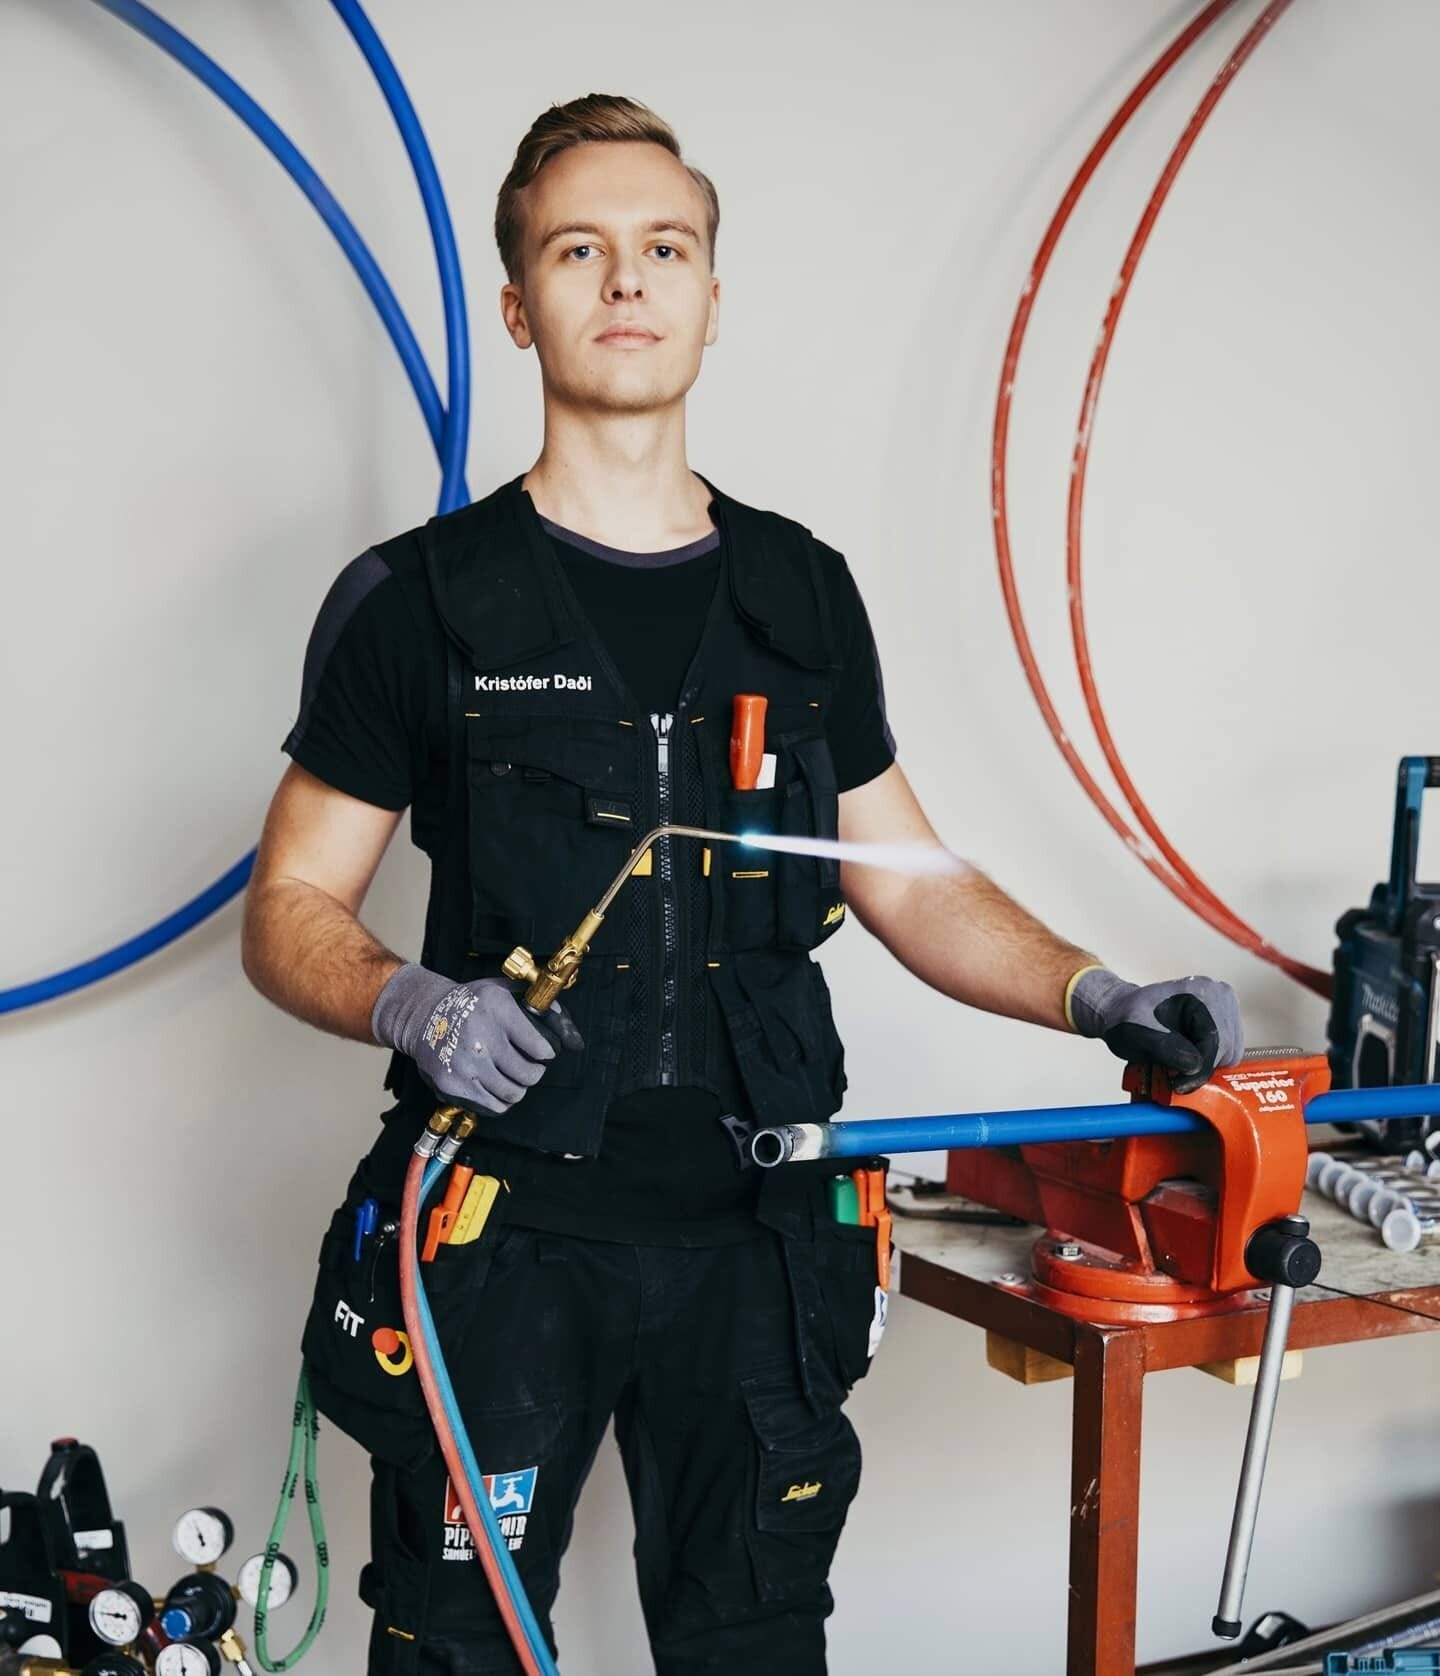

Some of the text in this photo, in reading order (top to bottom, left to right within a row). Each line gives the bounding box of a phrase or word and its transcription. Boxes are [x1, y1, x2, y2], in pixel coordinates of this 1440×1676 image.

[475, 674, 592, 691] Kristófer Daði
[1230, 1077, 1294, 1093] Superior
[1256, 1090, 1288, 1104] 160
[334, 1300, 365, 1337] FIT
